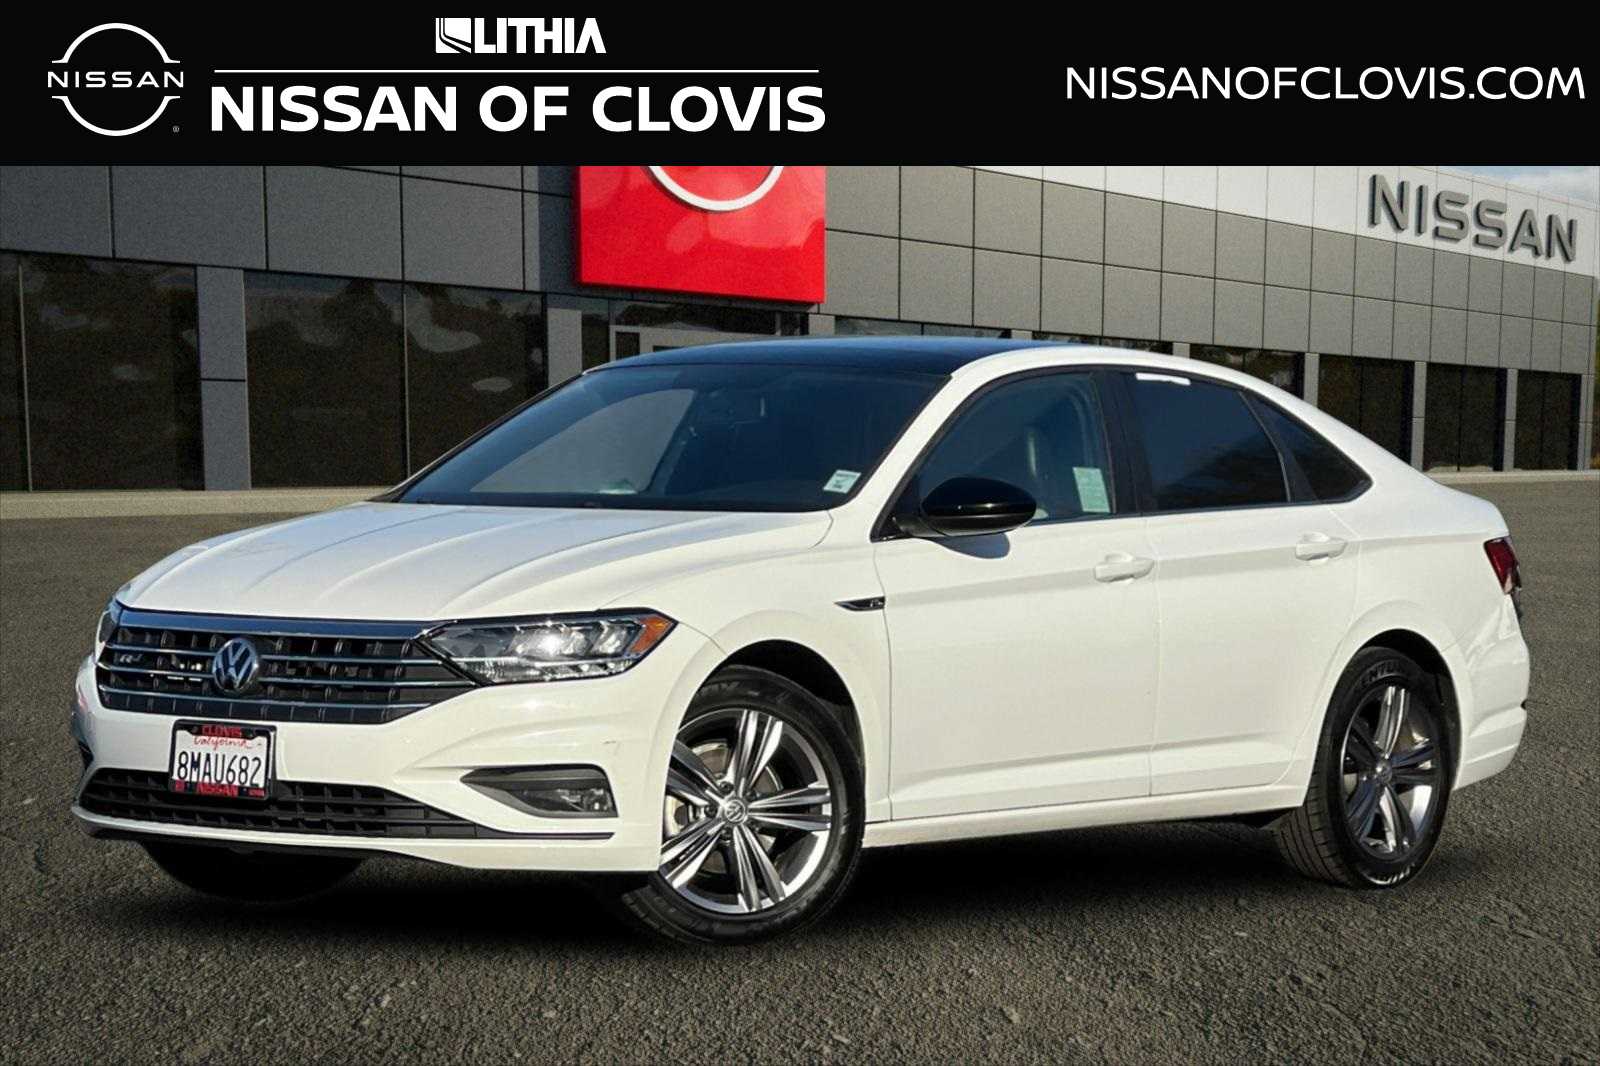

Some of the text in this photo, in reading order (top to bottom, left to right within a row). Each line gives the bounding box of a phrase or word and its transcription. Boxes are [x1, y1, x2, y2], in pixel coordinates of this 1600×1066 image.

[1368, 174, 1578, 263] NISSAN
[177, 751, 262, 787] 8MAU682
[198, 782, 239, 797] NISSAN
